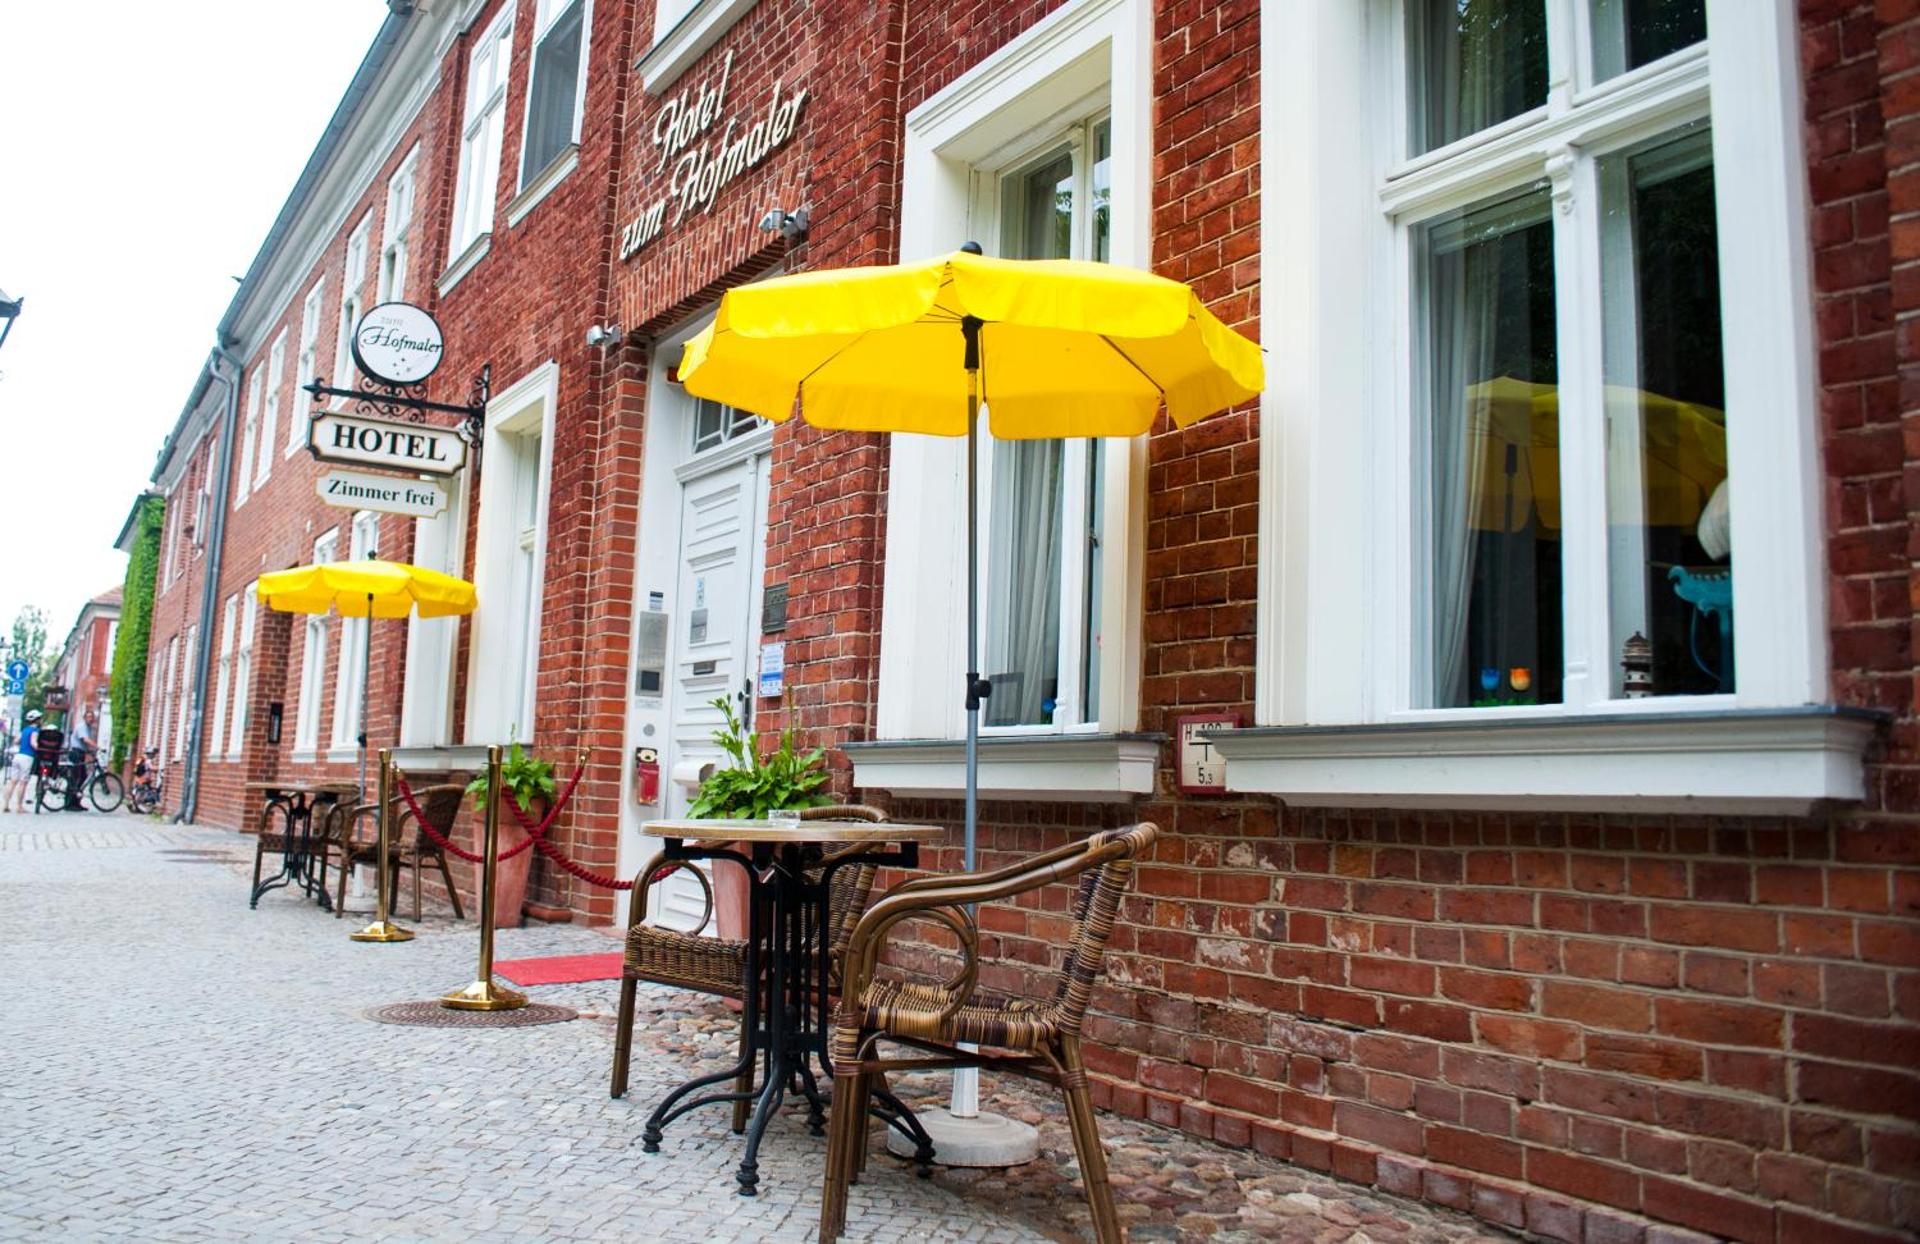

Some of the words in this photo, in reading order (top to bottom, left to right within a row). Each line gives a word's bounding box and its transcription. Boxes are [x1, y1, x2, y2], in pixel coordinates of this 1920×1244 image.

[653, 49, 734, 174] Hotel
[619, 199, 666, 260] zum
[670, 79, 808, 227] Hofmaler
[357, 326, 442, 354] Hofmaler
[332, 424, 447, 461] HOTEL
[328, 479, 400, 502] Zimmer
[405, 489, 435, 506] frei
